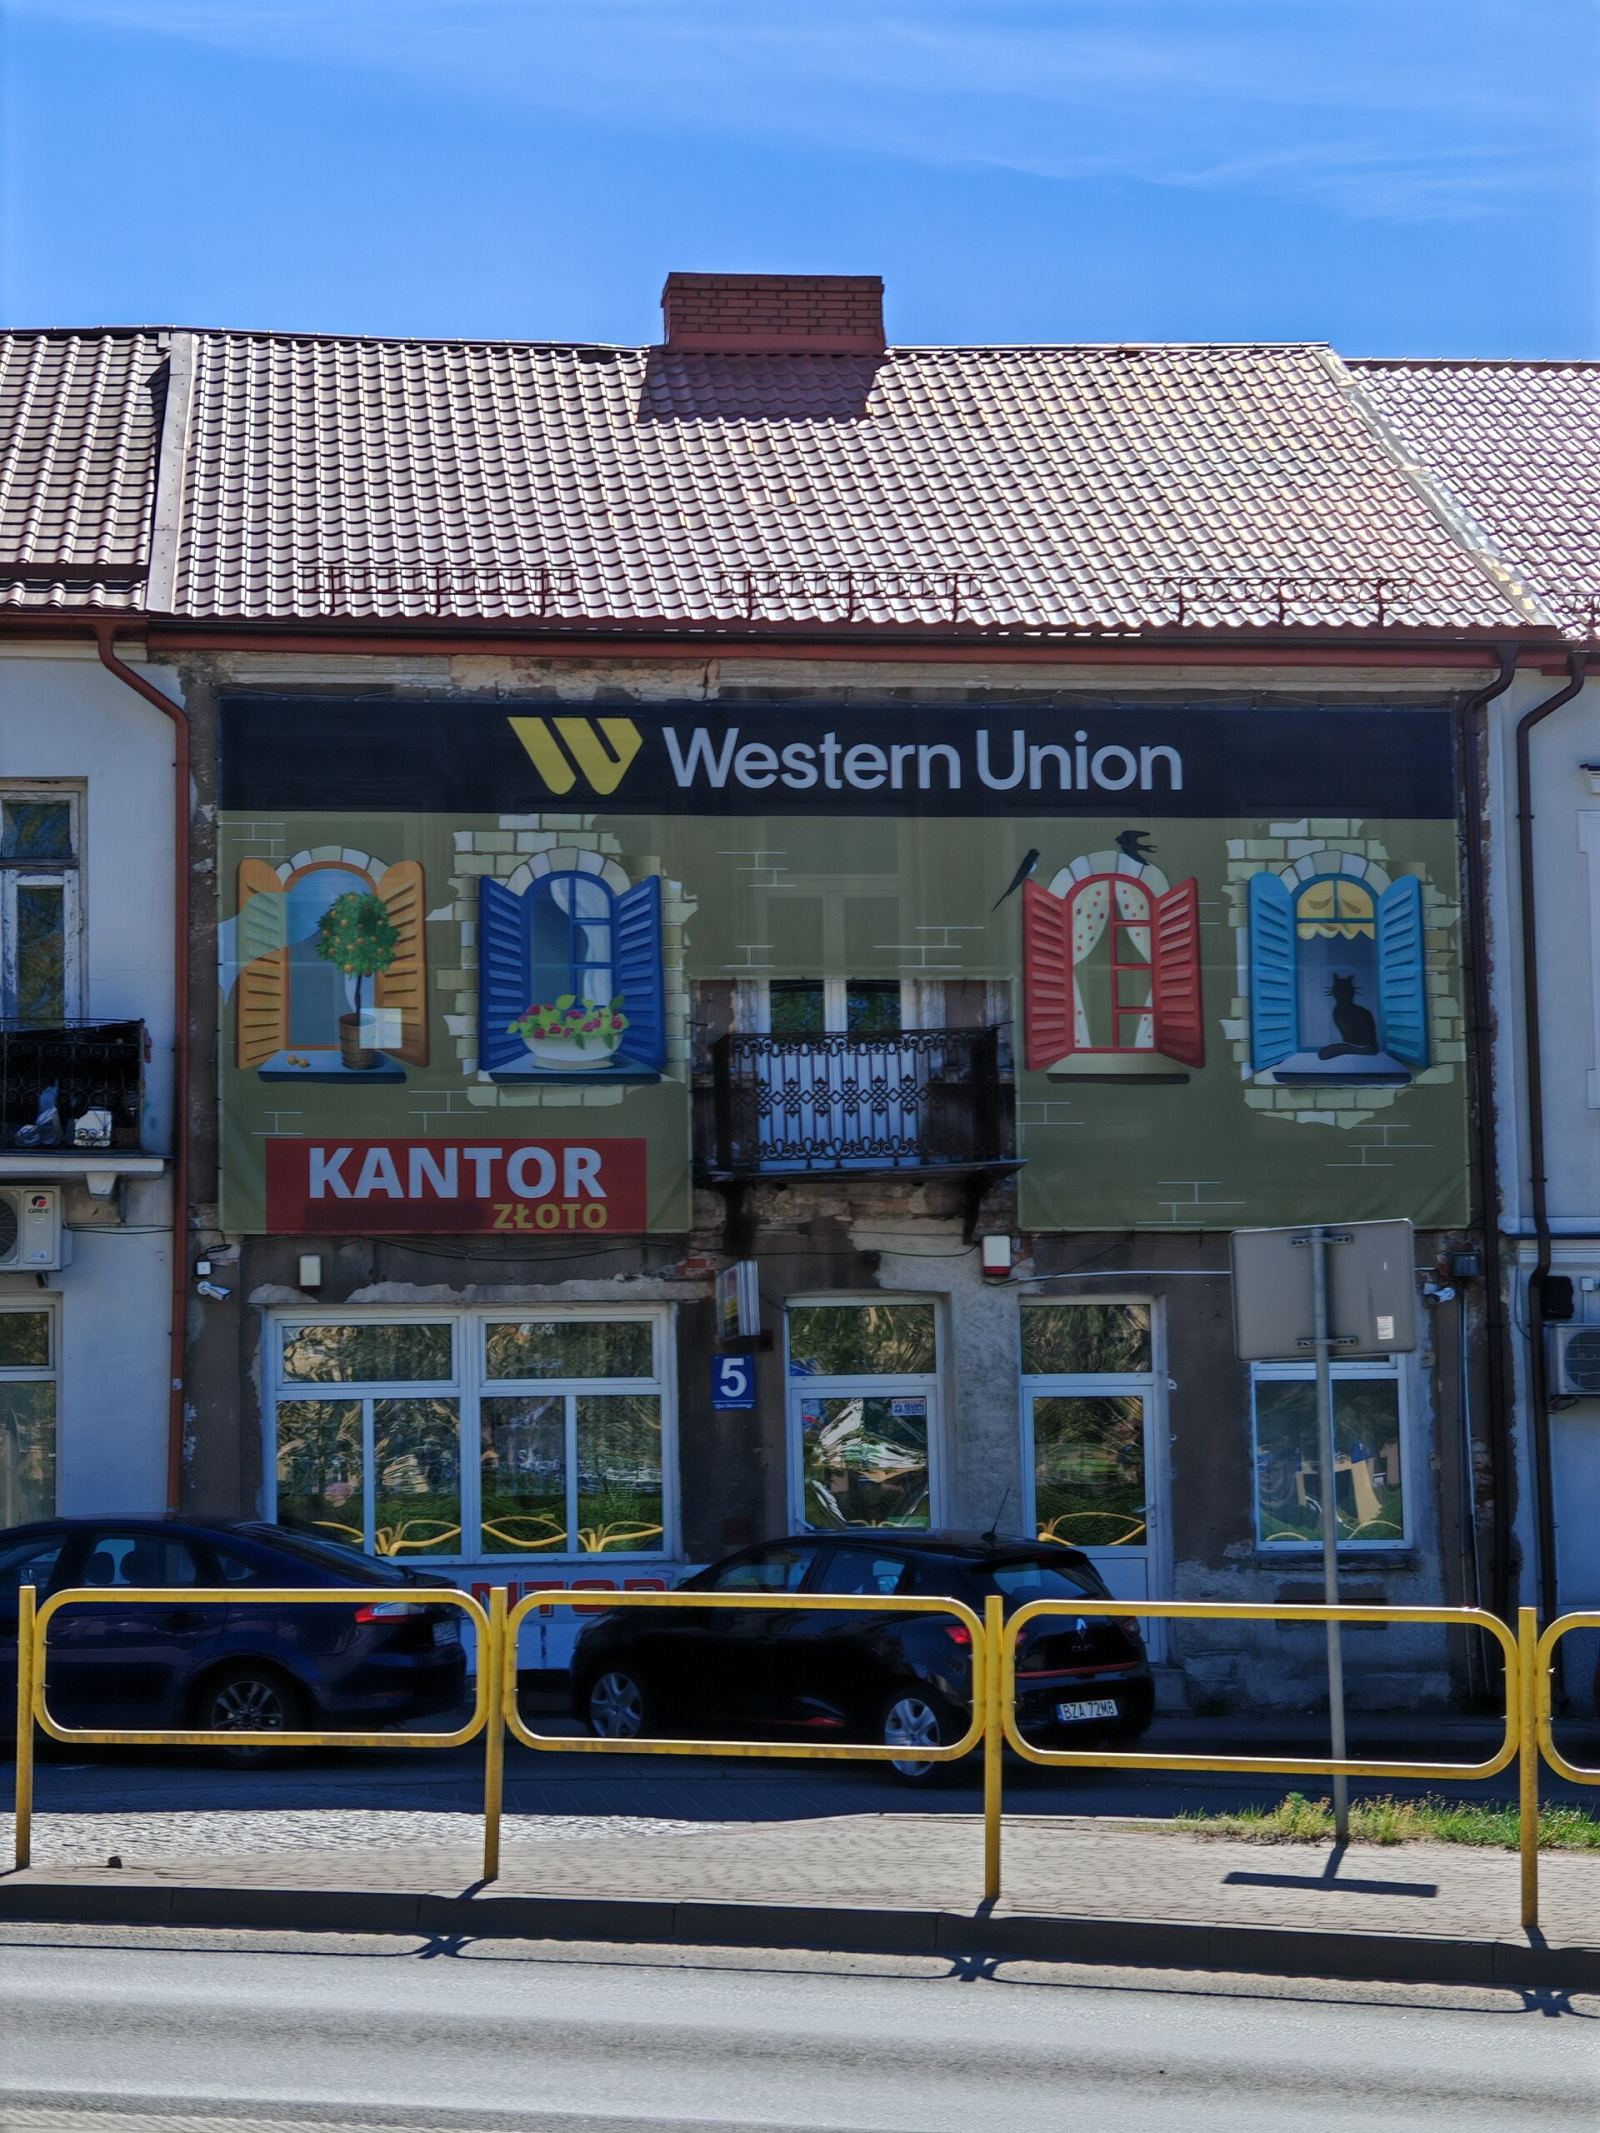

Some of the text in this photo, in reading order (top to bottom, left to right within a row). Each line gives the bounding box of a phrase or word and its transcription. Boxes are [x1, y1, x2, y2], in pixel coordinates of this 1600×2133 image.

[662, 727, 1183, 791] Western Union
[309, 1147, 607, 1198] KANTOR
[494, 1203, 607, 1229] ZŁOTO
[720, 1358, 747, 1397] 5
[1063, 1701, 1114, 1720] BZA 72MB
